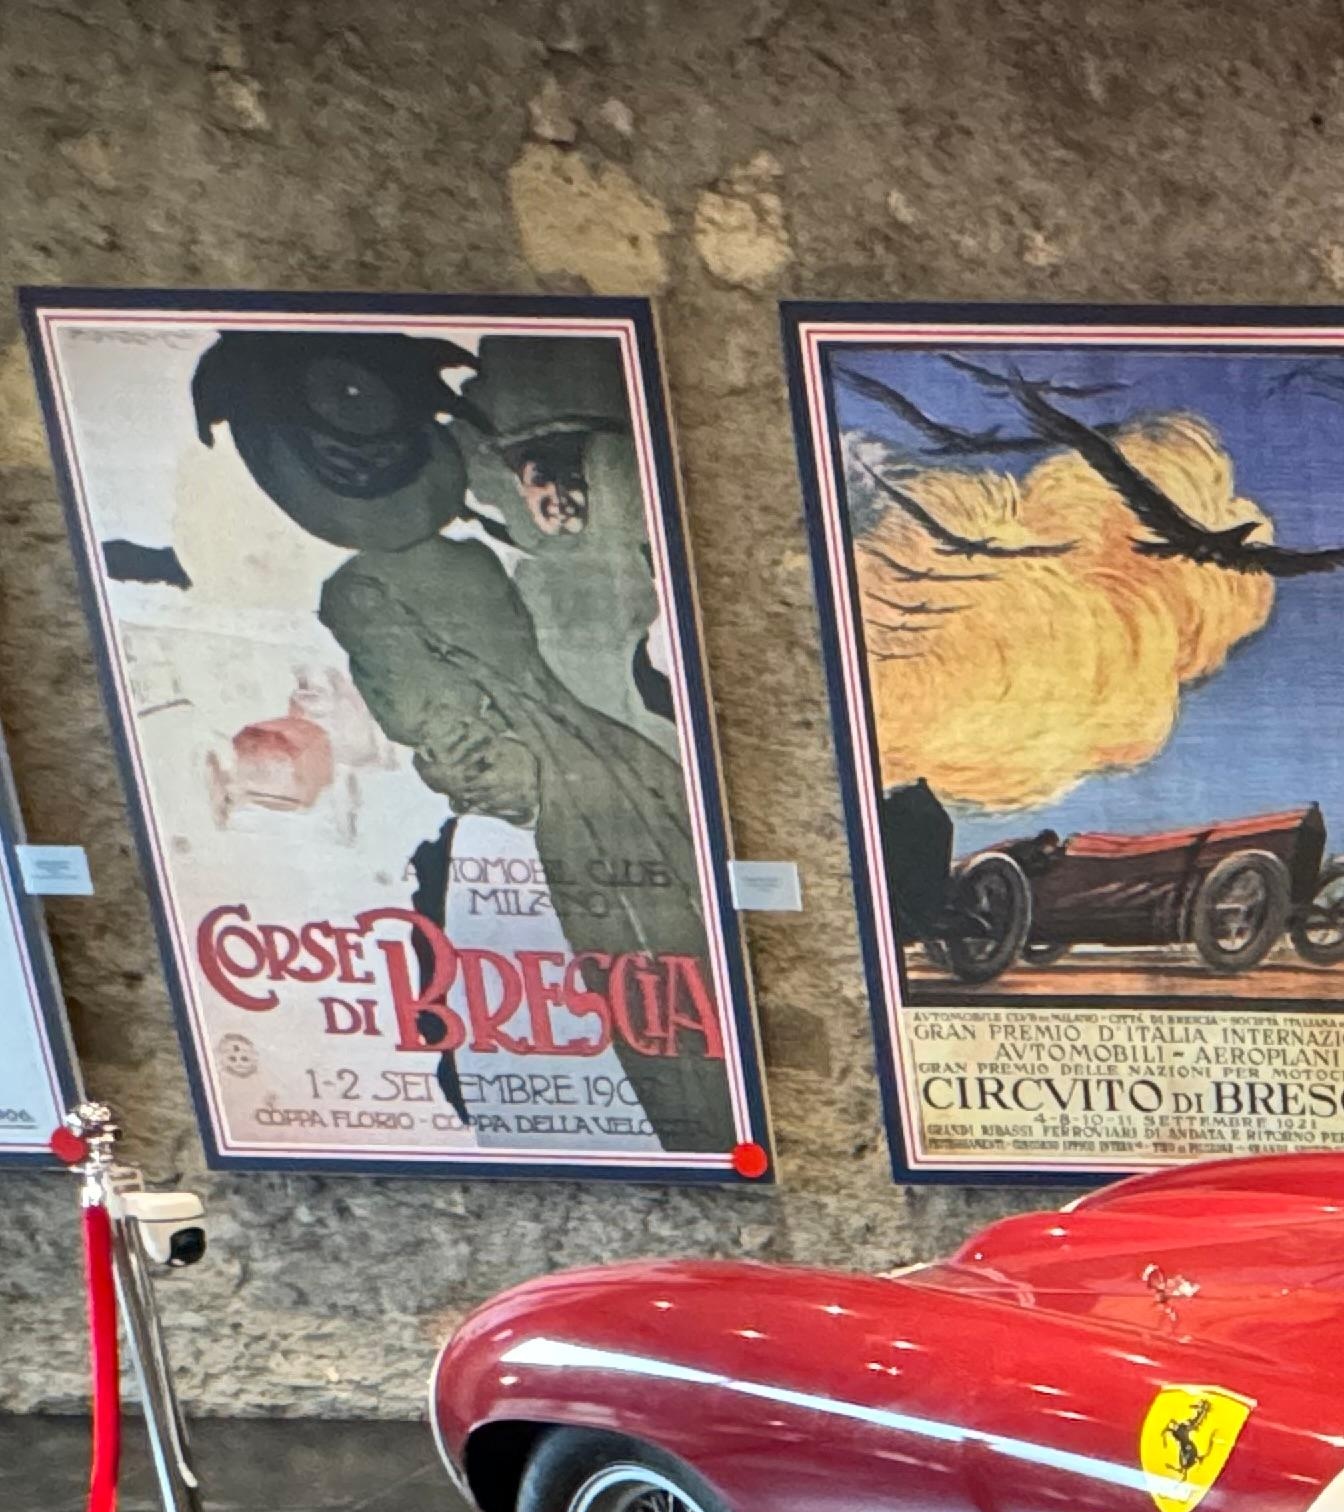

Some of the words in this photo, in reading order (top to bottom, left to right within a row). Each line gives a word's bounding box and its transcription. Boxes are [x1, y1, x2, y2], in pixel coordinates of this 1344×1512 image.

[197, 904, 375, 1011] CORSE
[320, 997, 383, 1037] DI
[355, 907, 726, 1059] BRESCIA
[914, 1023, 976, 1041] GRAN
[989, 1024, 1082, 1042] PREMIO
[1194, 1046, 1341, 1068] AEROPLANI
[919, 1062, 967, 1075] GRAN
[977, 1063, 1049, 1076] PREMIO
[1060, 1064, 1118, 1077] DELLE
[1128, 1064, 1212, 1079] NAZIONI
[1222, 1066, 1260, 1080] PER
[306, 1068, 360, 1100] 1-2
[1171, 1092, 1204, 1114] DI
[1144, 1114, 1268, 1129] SETTEMBRE
